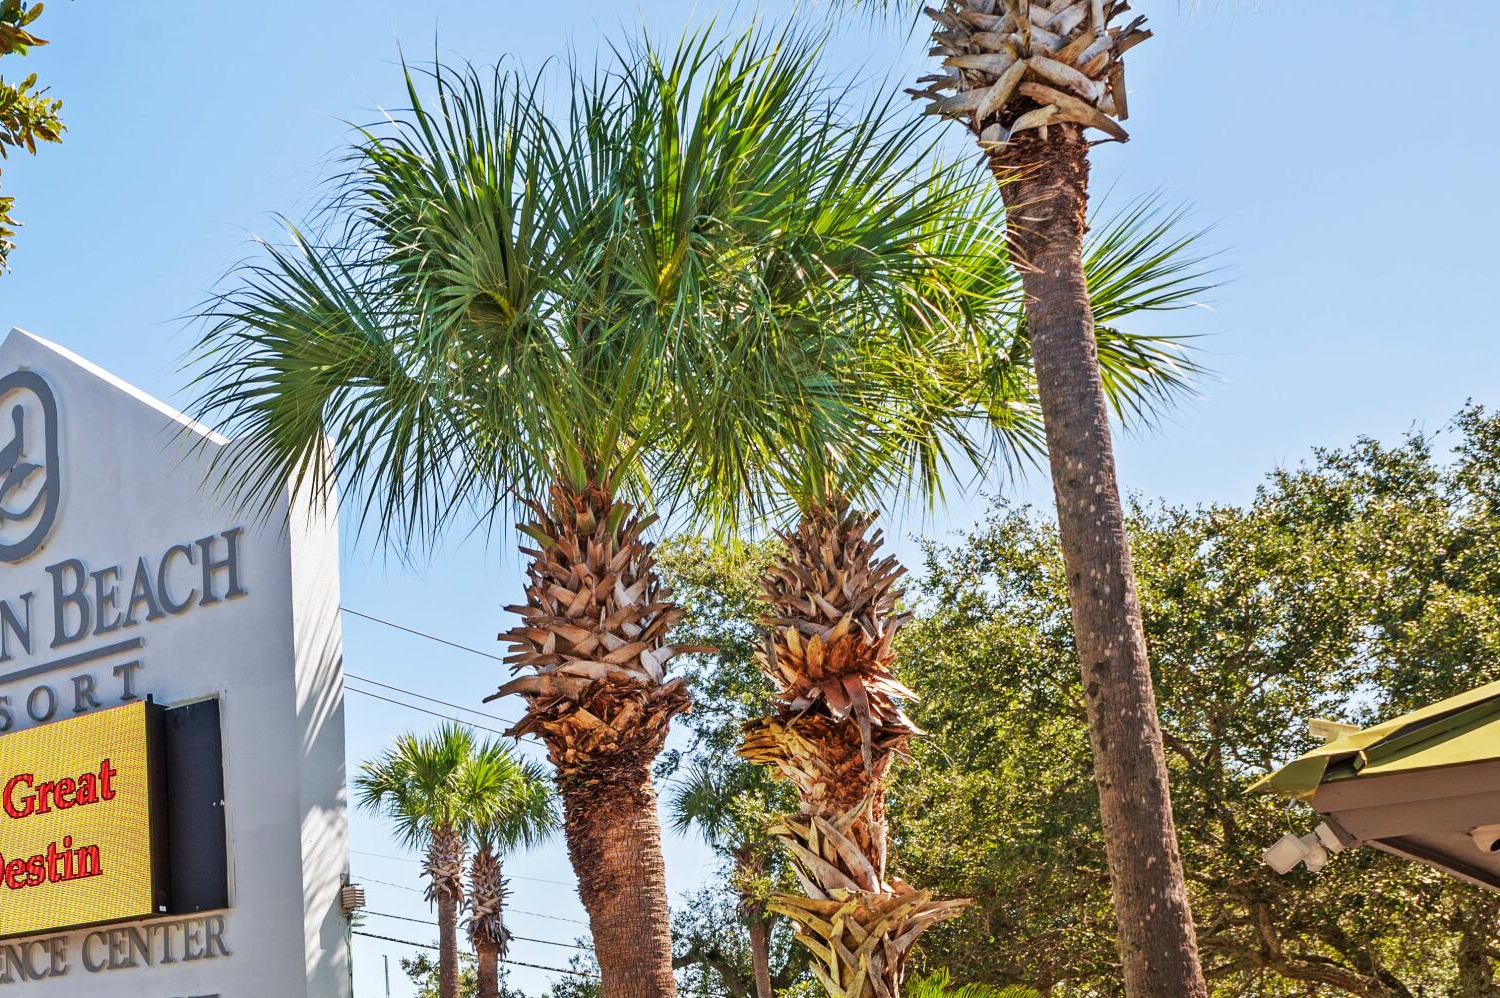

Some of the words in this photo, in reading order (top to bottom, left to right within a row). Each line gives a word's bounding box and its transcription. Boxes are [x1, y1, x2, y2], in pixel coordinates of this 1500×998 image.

[45, 526, 248, 649] BEACH
[2, 758, 117, 819] Great
[81, 915, 231, 973] CENTER
